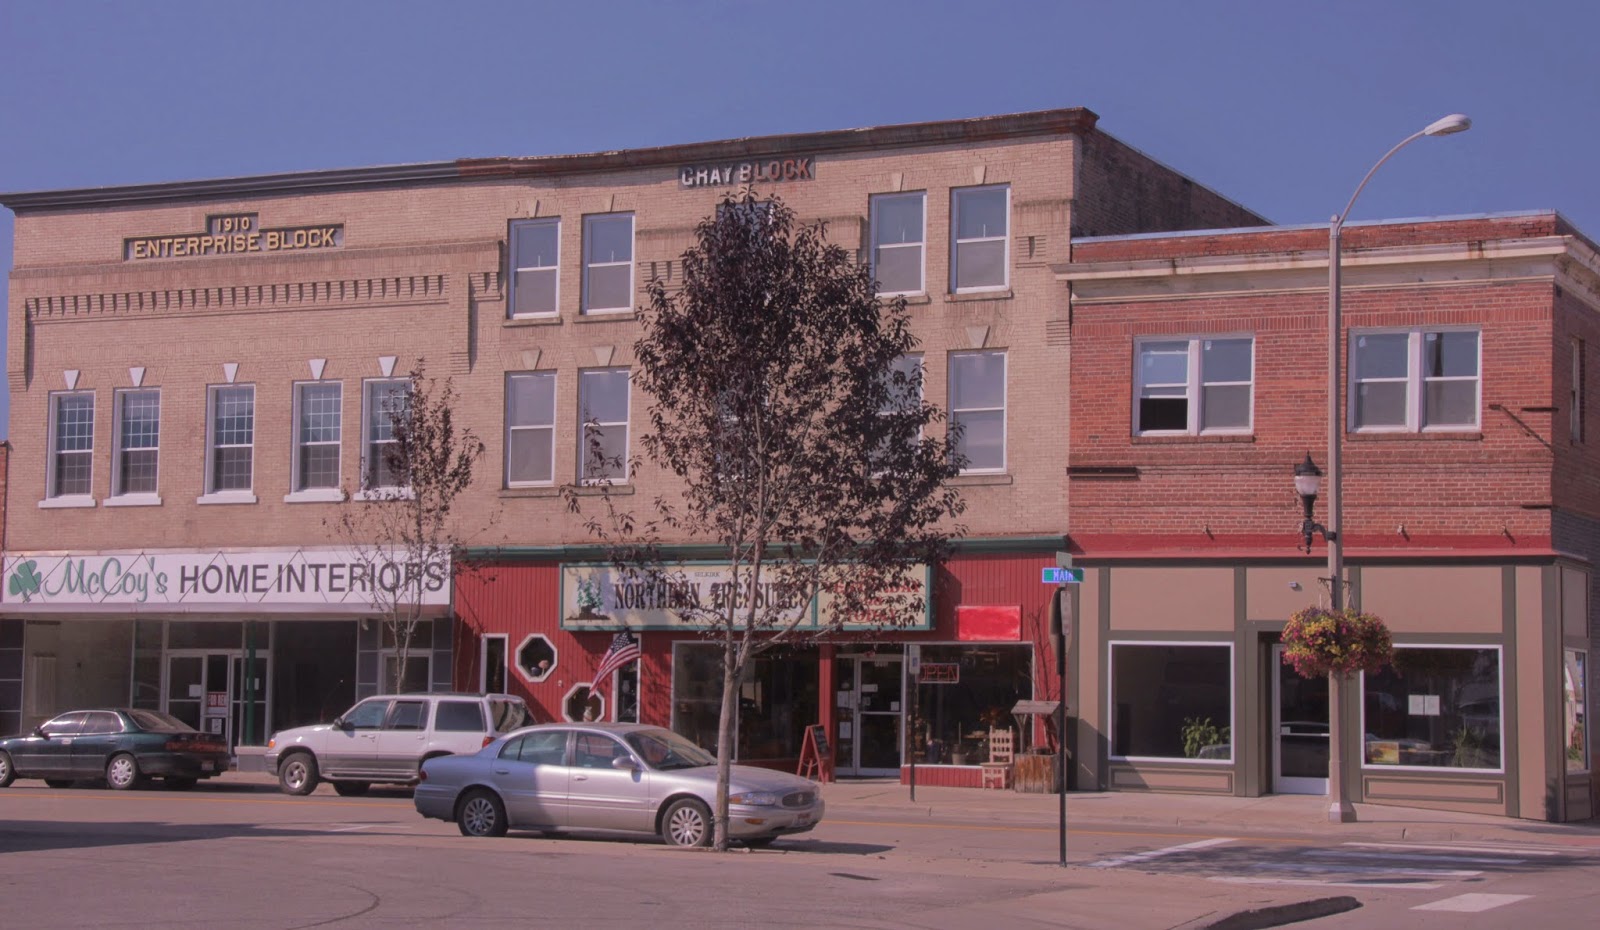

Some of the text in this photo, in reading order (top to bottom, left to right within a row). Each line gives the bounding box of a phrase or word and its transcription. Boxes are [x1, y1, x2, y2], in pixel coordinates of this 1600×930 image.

[682, 158, 813, 186] GRAY BLOCK
[217, 216, 250, 233] 1910
[134, 228, 336, 259] ENTERPRISE BLOCK
[45, 557, 444, 602] McCoy's HOME INTERIORS
[1053, 569, 1074, 581] MAIN
